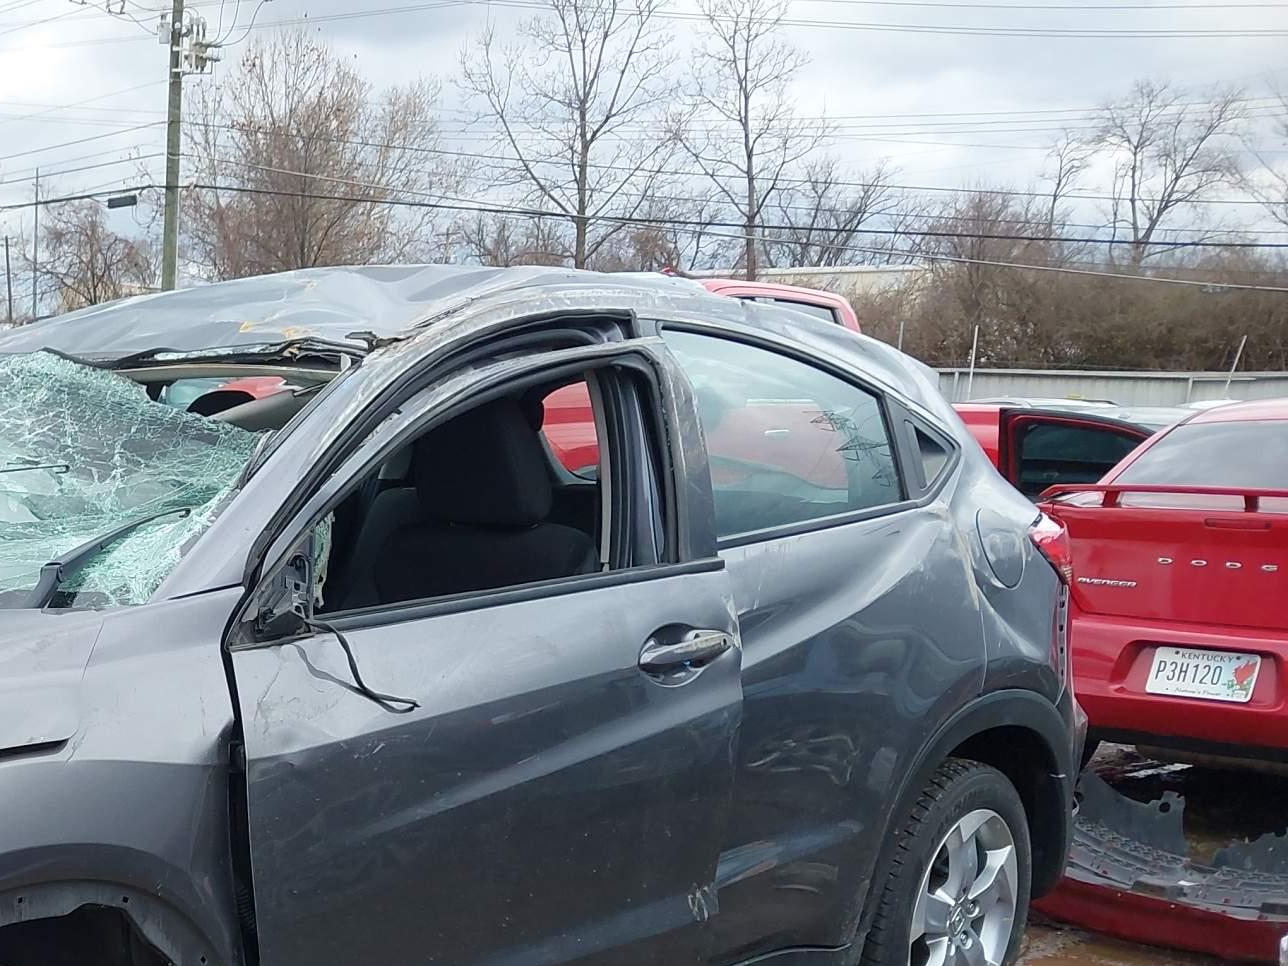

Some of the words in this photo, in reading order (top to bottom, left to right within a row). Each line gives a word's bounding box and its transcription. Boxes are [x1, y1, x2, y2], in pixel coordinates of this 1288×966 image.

[1157, 557, 1279, 573] DODG
[1077, 577, 1137, 588] AVENGER
[1181, 652, 1234, 663] KENTUCKY
[1155, 660, 1223, 686] P3H120
